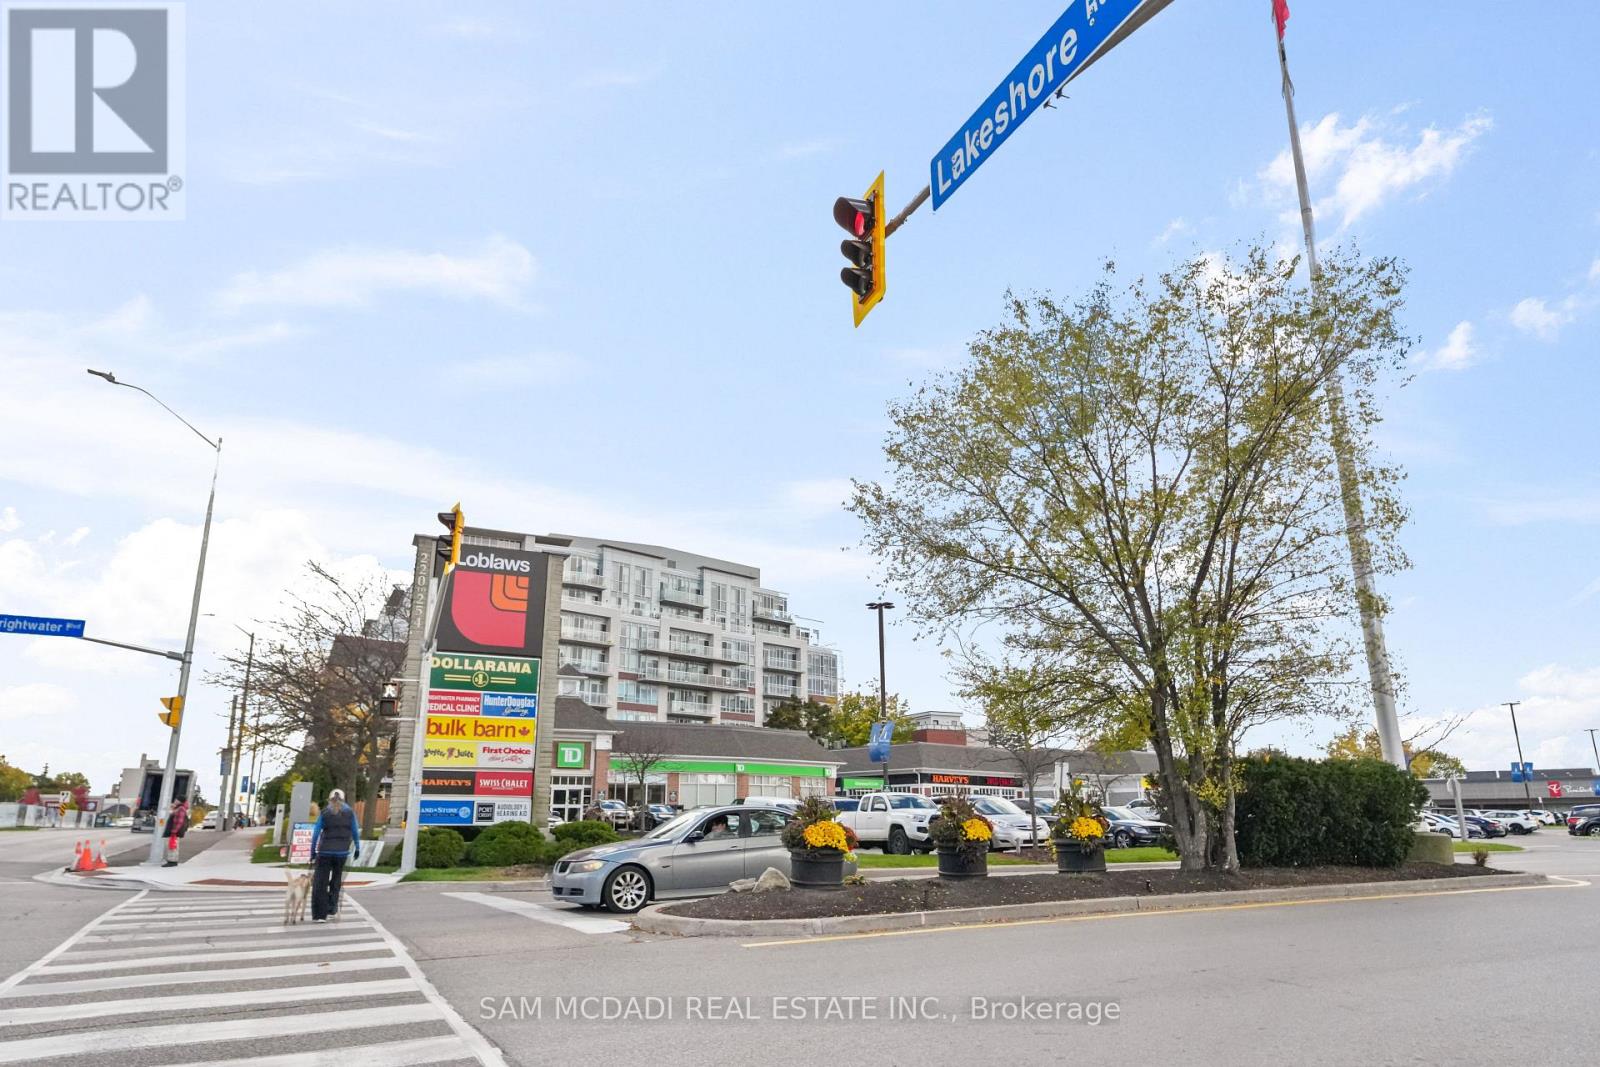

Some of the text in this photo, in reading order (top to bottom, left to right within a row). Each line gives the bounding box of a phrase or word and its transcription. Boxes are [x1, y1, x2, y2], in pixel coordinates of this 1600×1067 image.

[936, 27, 1078, 196] Lakeshore
[0, 618, 62, 632] rightwater
[430, 656, 532, 674] DOLLARAMA
[430, 703, 480, 713] EDICAL CLINIC
[427, 719, 516, 738] bulk barn
[560, 747, 582, 763] TD
[480, 779, 528, 788] SWISS CHALET
[932, 774, 969, 784] HARVEY'S
